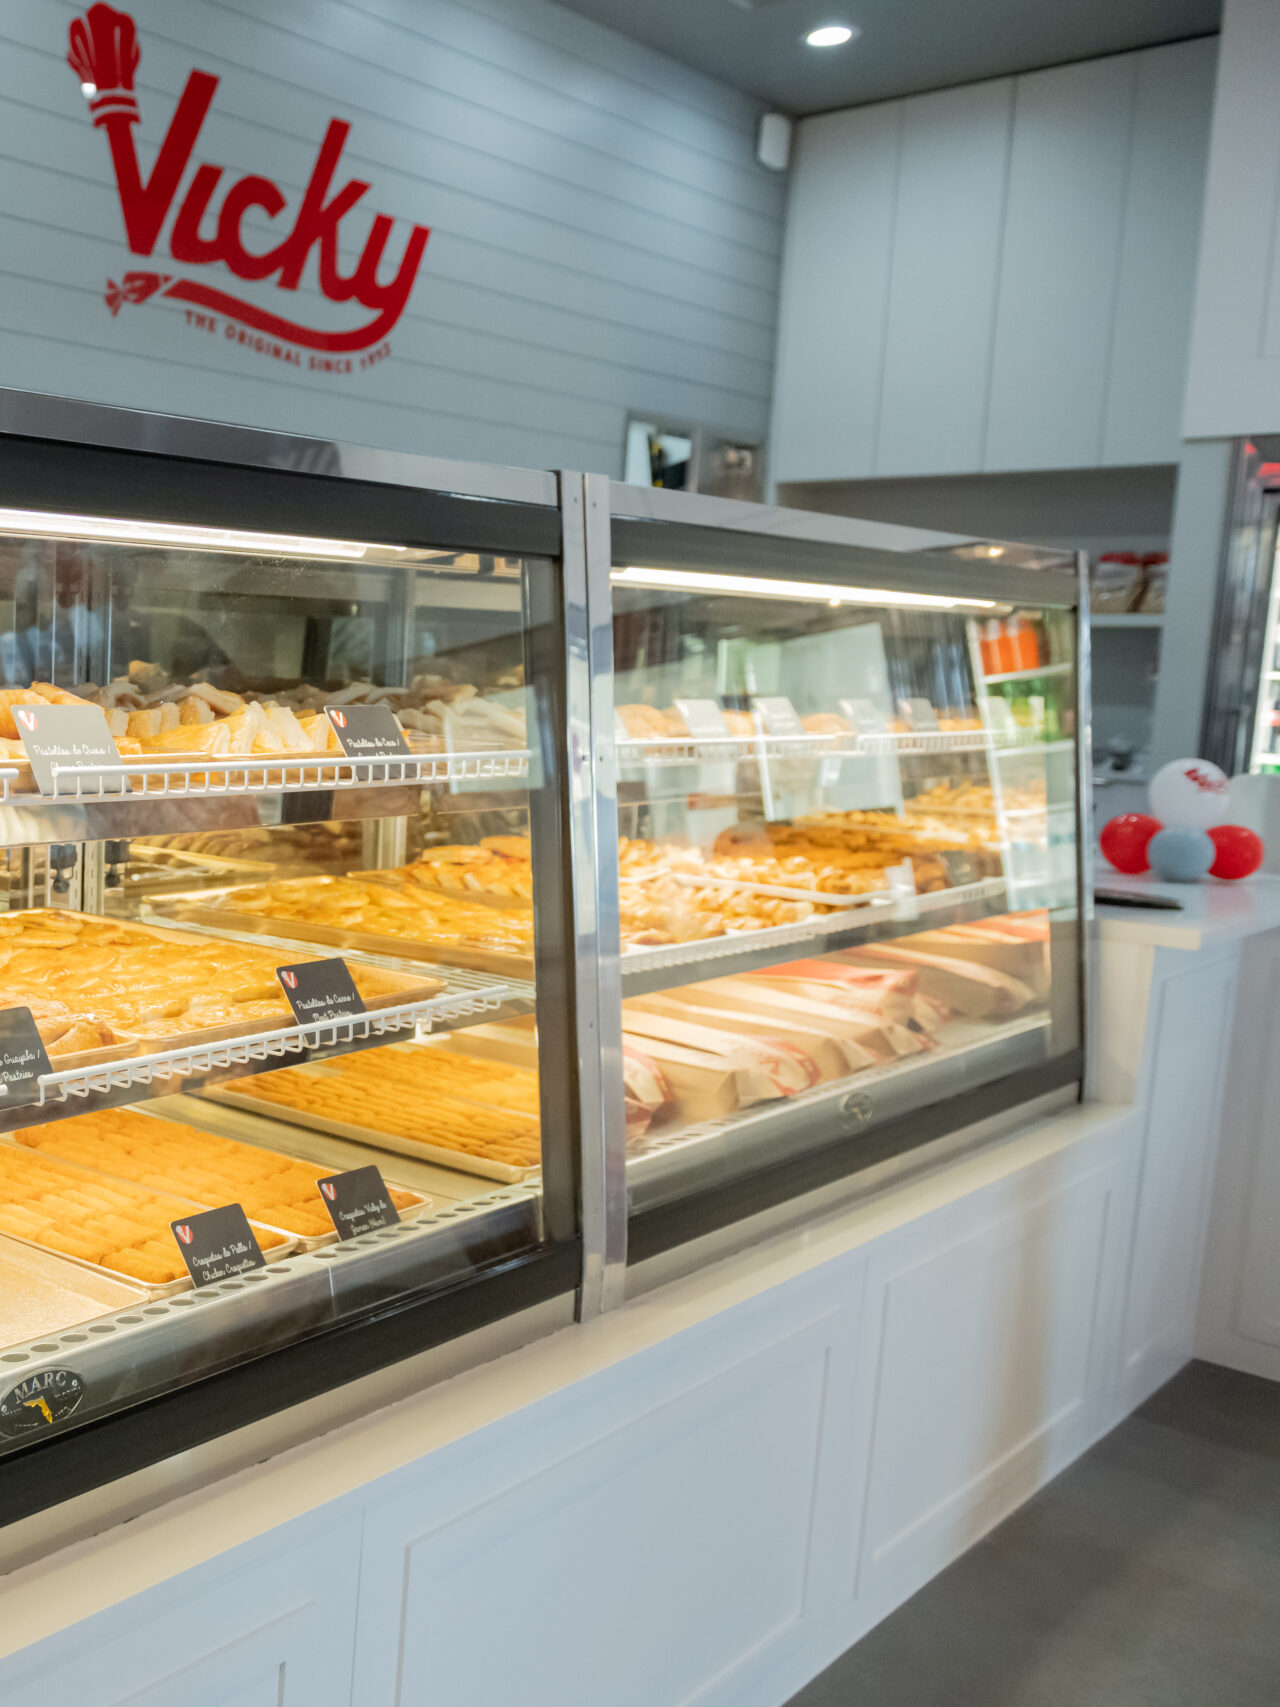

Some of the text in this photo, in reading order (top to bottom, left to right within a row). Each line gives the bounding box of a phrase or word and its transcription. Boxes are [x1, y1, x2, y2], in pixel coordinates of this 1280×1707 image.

[67, 2, 430, 352] Vicky
[186, 310, 216, 333] THE
[225, 324, 301, 367] ORIGINAL
[309, 355, 352, 374] SINCE
[3, 1049, 36, 1066] Guayaba
[1, 1070, 34, 1083] Pastries
[14, 1370, 67, 1405] MARC
